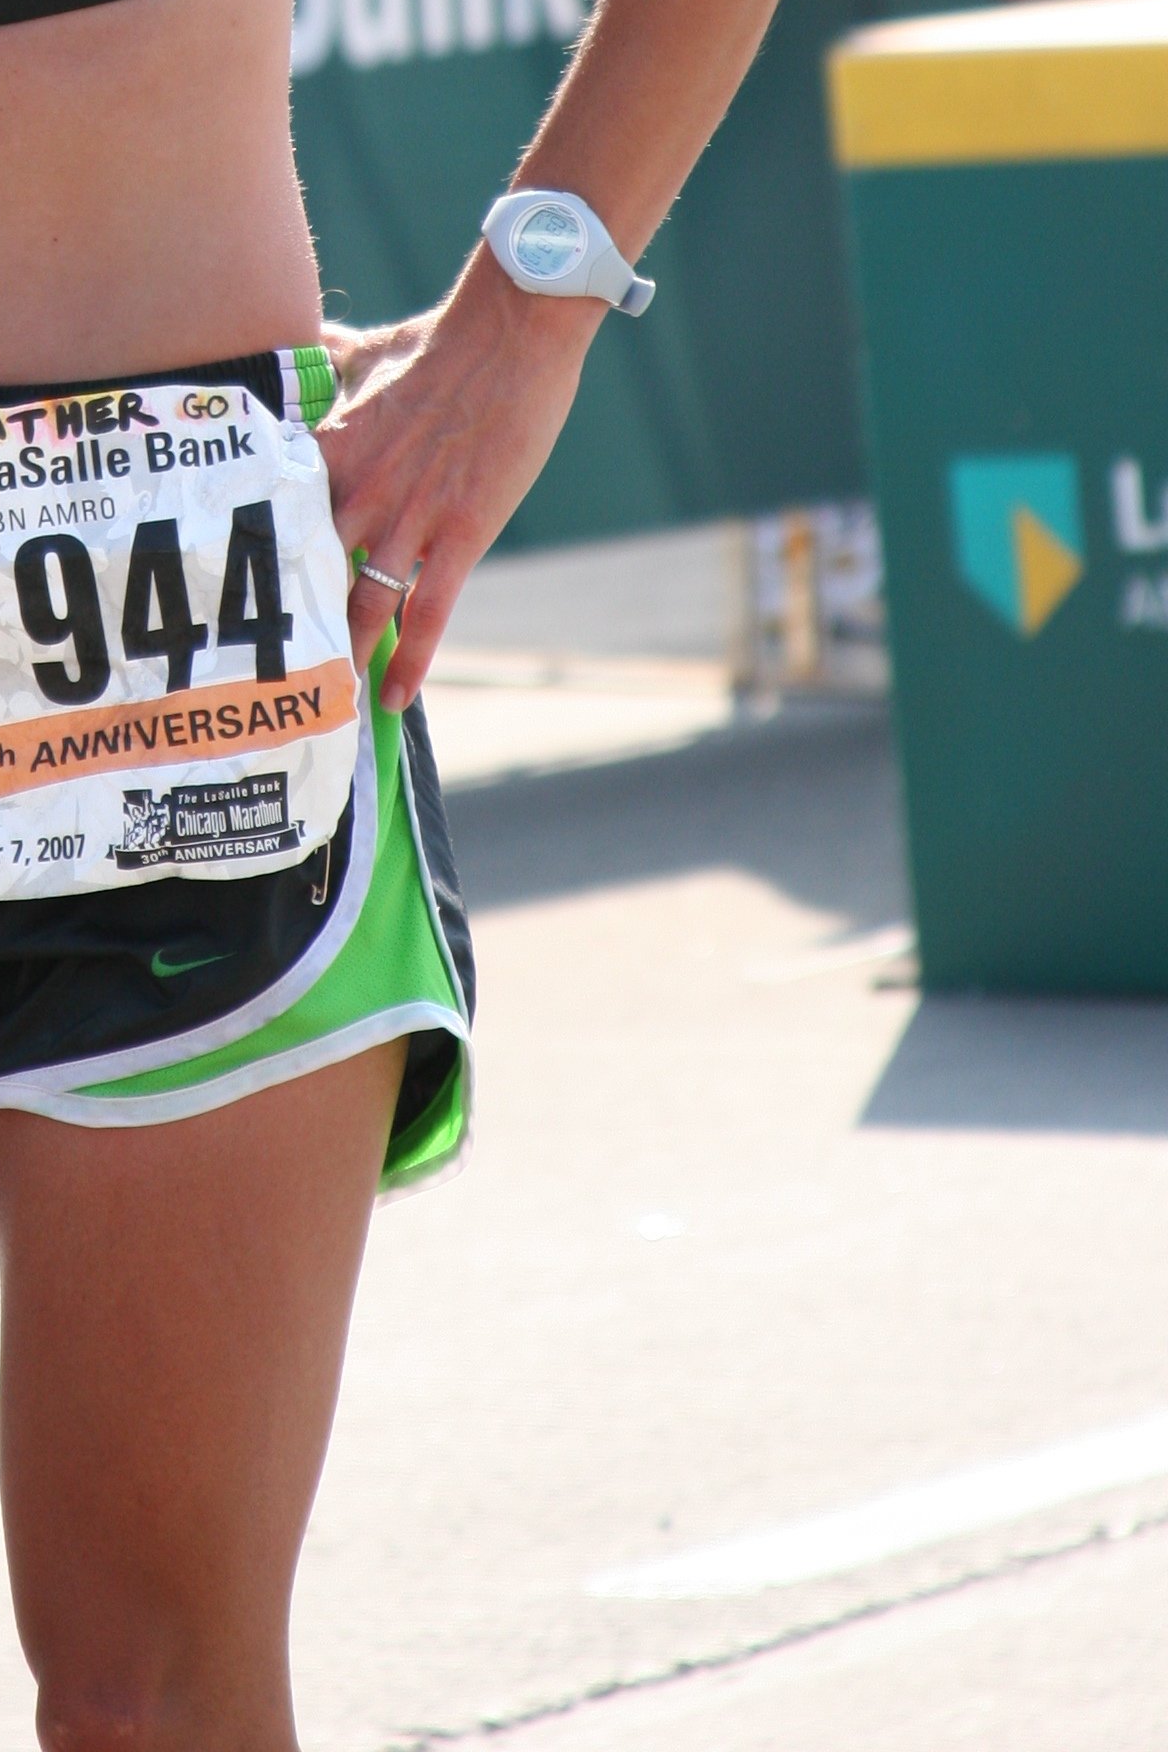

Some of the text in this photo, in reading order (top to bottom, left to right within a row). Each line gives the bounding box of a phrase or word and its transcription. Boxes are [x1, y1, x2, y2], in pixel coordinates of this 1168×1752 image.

[146, 425, 256, 474] Bank
[38, 497, 116, 529] AMRO
[13, 500, 293, 706] 944
[30, 686, 322, 773] ANNIVERSARY
[178, 781, 280, 805] The LaSalle Bank
[175, 799, 283, 838] Chicago Marathon
[12, 842, 29, 867] 7,
[37, 835, 85, 861] 2007
[140, 836, 281, 866] 30th ANNIVERSARY
